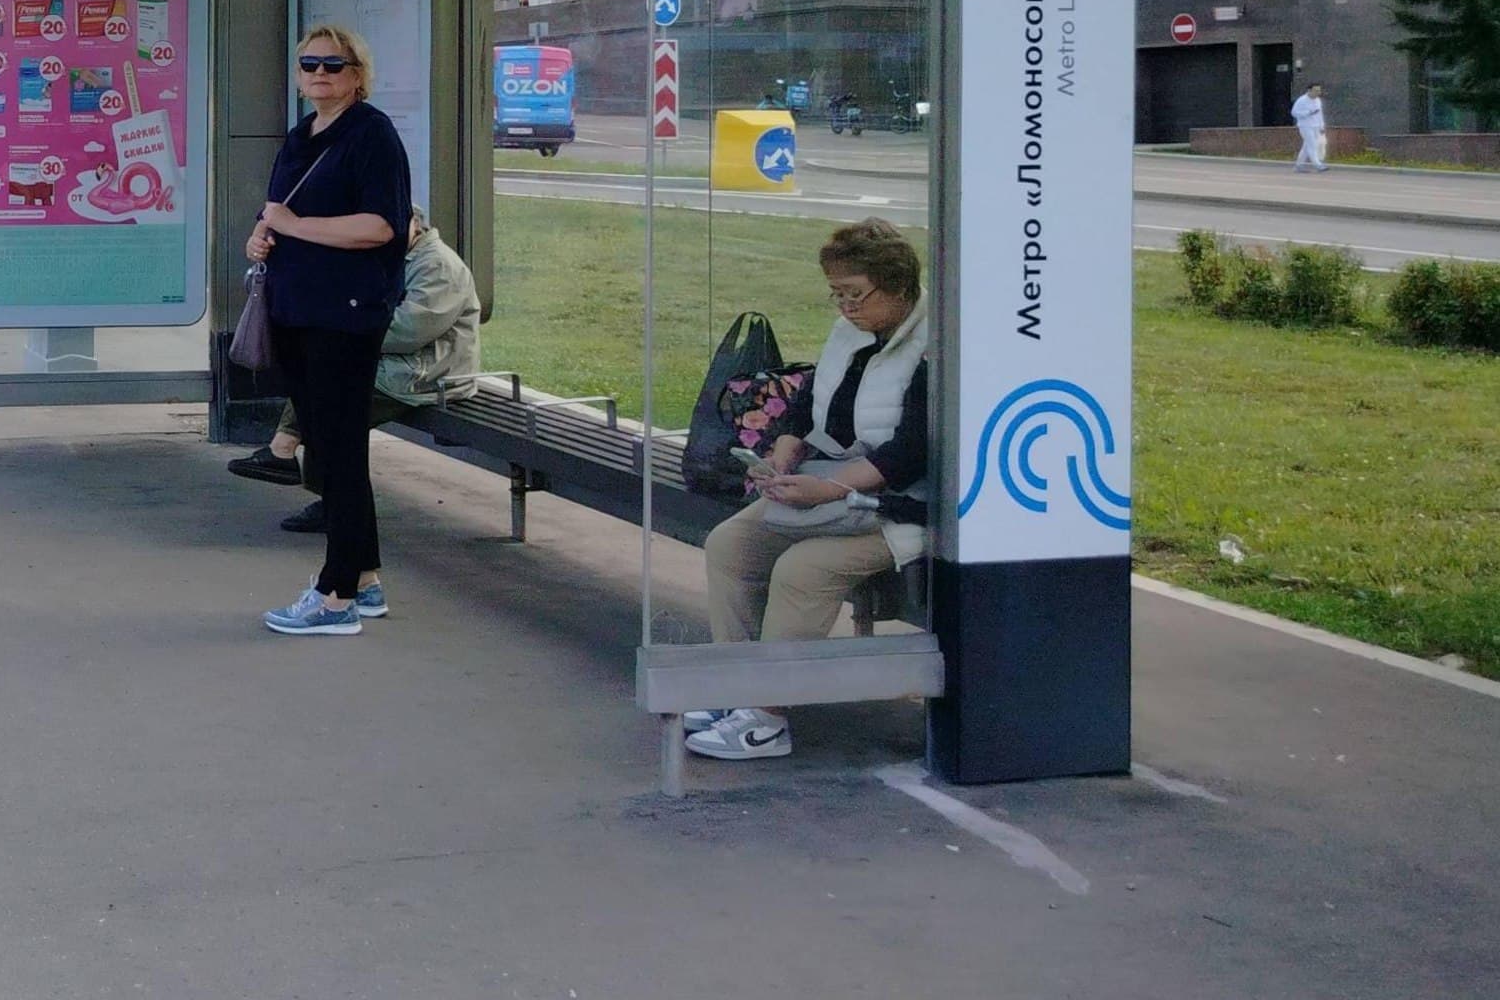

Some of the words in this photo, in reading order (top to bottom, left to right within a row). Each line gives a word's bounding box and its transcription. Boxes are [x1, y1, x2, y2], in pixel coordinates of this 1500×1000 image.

[43, 21, 63, 34] 20
[107, 23, 127, 35] 20
[154, 47, 173, 60] 20
[1057, 20, 1075, 96] Metro
[42, 62, 60, 75] 20
[503, 79, 567, 95] OZON
[102, 96, 121, 109] 20
[43, 162, 60, 175] 30
[1017, 219, 1047, 340] Метро
